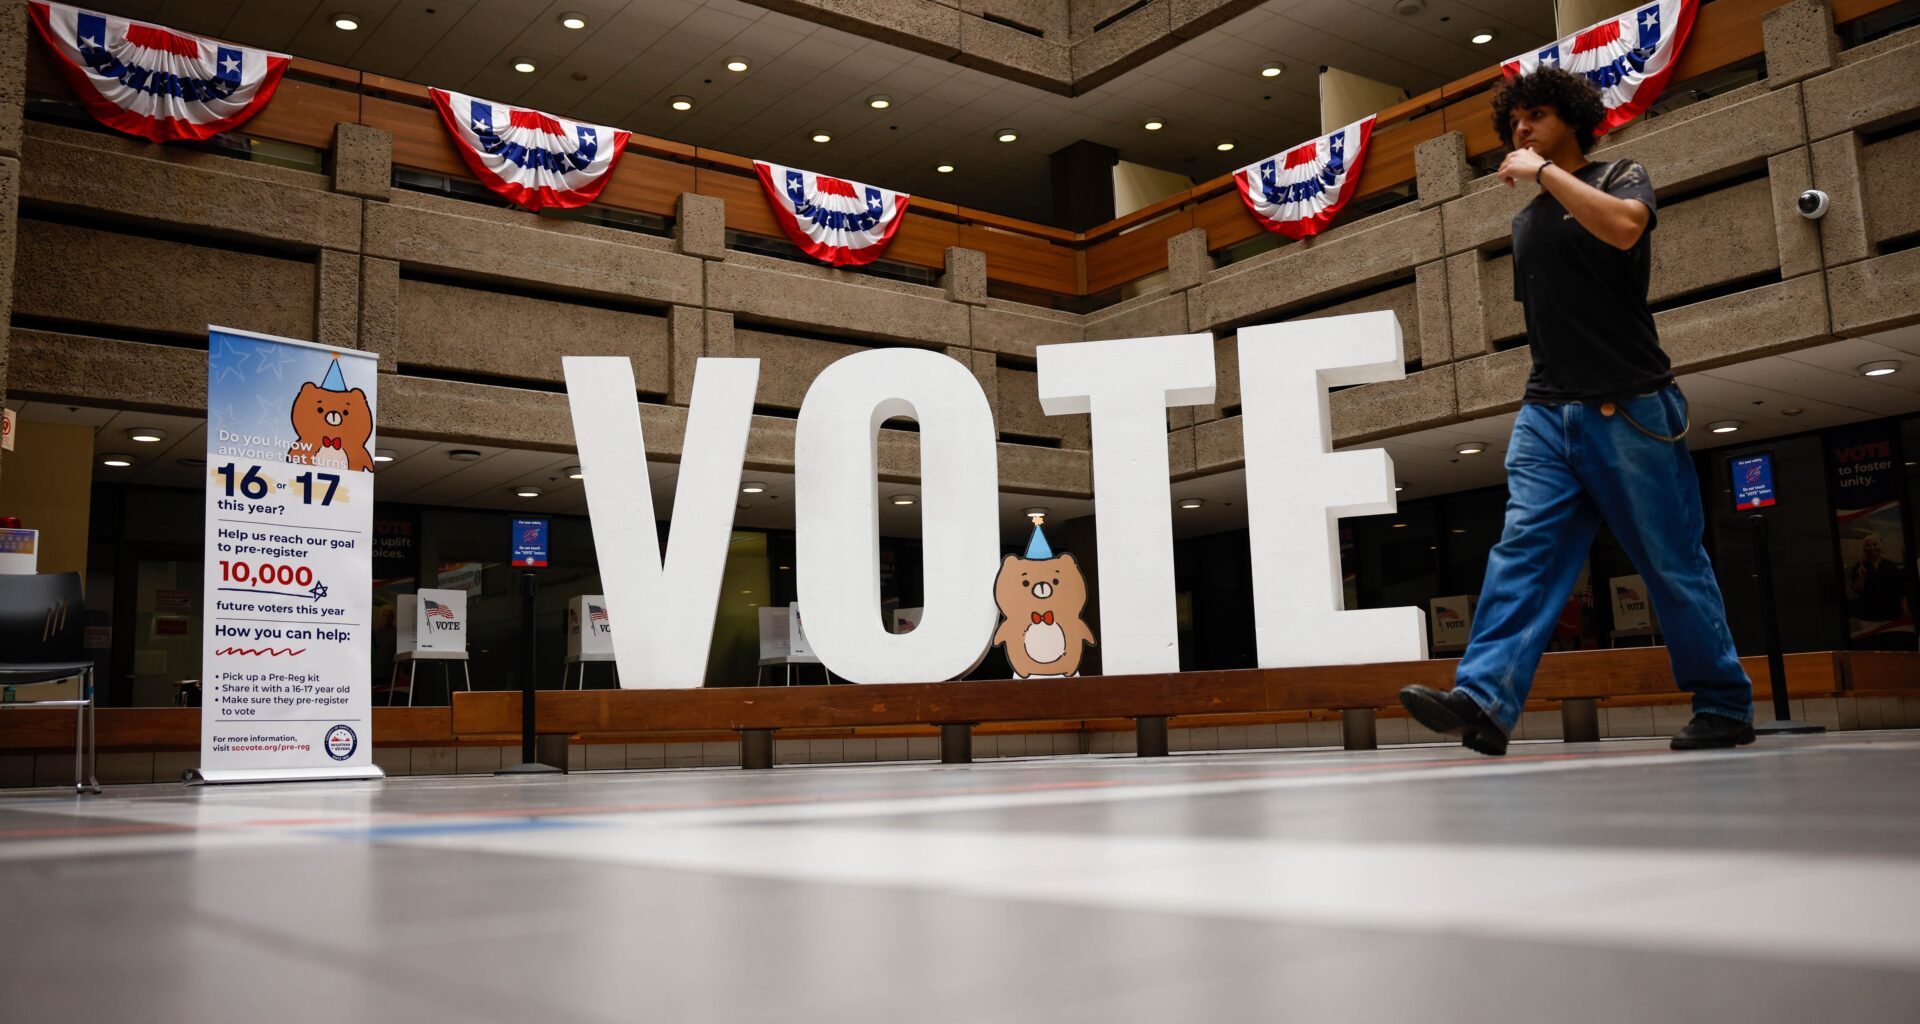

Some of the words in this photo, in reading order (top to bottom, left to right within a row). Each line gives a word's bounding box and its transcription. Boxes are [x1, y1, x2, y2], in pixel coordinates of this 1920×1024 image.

[219, 429, 239, 441] Do
[244, 433, 270, 447] you
[274, 435, 313, 452] know
[218, 445, 274, 460] anyone
[277, 452, 307, 465] that
[310, 455, 347, 469] turns
[1833, 441, 1890, 463] VOTE
[1838, 466, 1852, 476] to
[1854, 460, 1893, 473] foster
[217, 462, 268, 500] 16
[276, 482, 287, 490] or
[296, 471, 341, 506] 17
[1840, 475, 1876, 488] unity.
[562, 310, 1428, 688] VOTE
[217, 499, 244, 511] this
[248, 503, 285, 515] year?
[374, 521, 412, 534] OTE
[218, 528, 248, 541] Help
[251, 531, 266, 541] us
[269, 534, 303, 544] reach
[306, 536, 328, 546] our
[330, 539, 355, 549] goal
[381, 536, 411, 548] uplift
[217, 542, 231, 552] to
[235, 543, 308, 558] pre-register
[373, 548, 405, 558] oices.
[219, 560, 313, 587] 10,000
[216, 600, 255, 612] future
[258, 604, 293, 614] voters
[296, 604, 318, 615] this
[321, 607, 345, 617] year
[1626, 602, 1644, 611] VOTE
[436, 621, 461, 631] VOTE
[1445, 620, 1464, 628] VOTE
[215, 624, 251, 637] How
[254, 628, 281, 640] you
[286, 629, 312, 640] can
[316, 628, 351, 643] help:
[222, 672, 243, 681] Pick
[246, 674, 258, 683] up
[269, 673, 306, 683] Pre-Reg
[307, 673, 320, 682] kit
[222, 684, 250, 693] Share
[252, 684, 259, 693] it
[261, 684, 282, 693] with
[292, 685, 313, 693] 16-17
[315, 686, 334, 695] year
[336, 685, 350, 693] old
[222, 695, 249, 704] Make
[273, 696, 294, 706] they
[296, 696, 349, 706] pre-register
[250, 735, 298, 743] information,
[231, 744, 310, 752] sccvote.org/pre-reg
